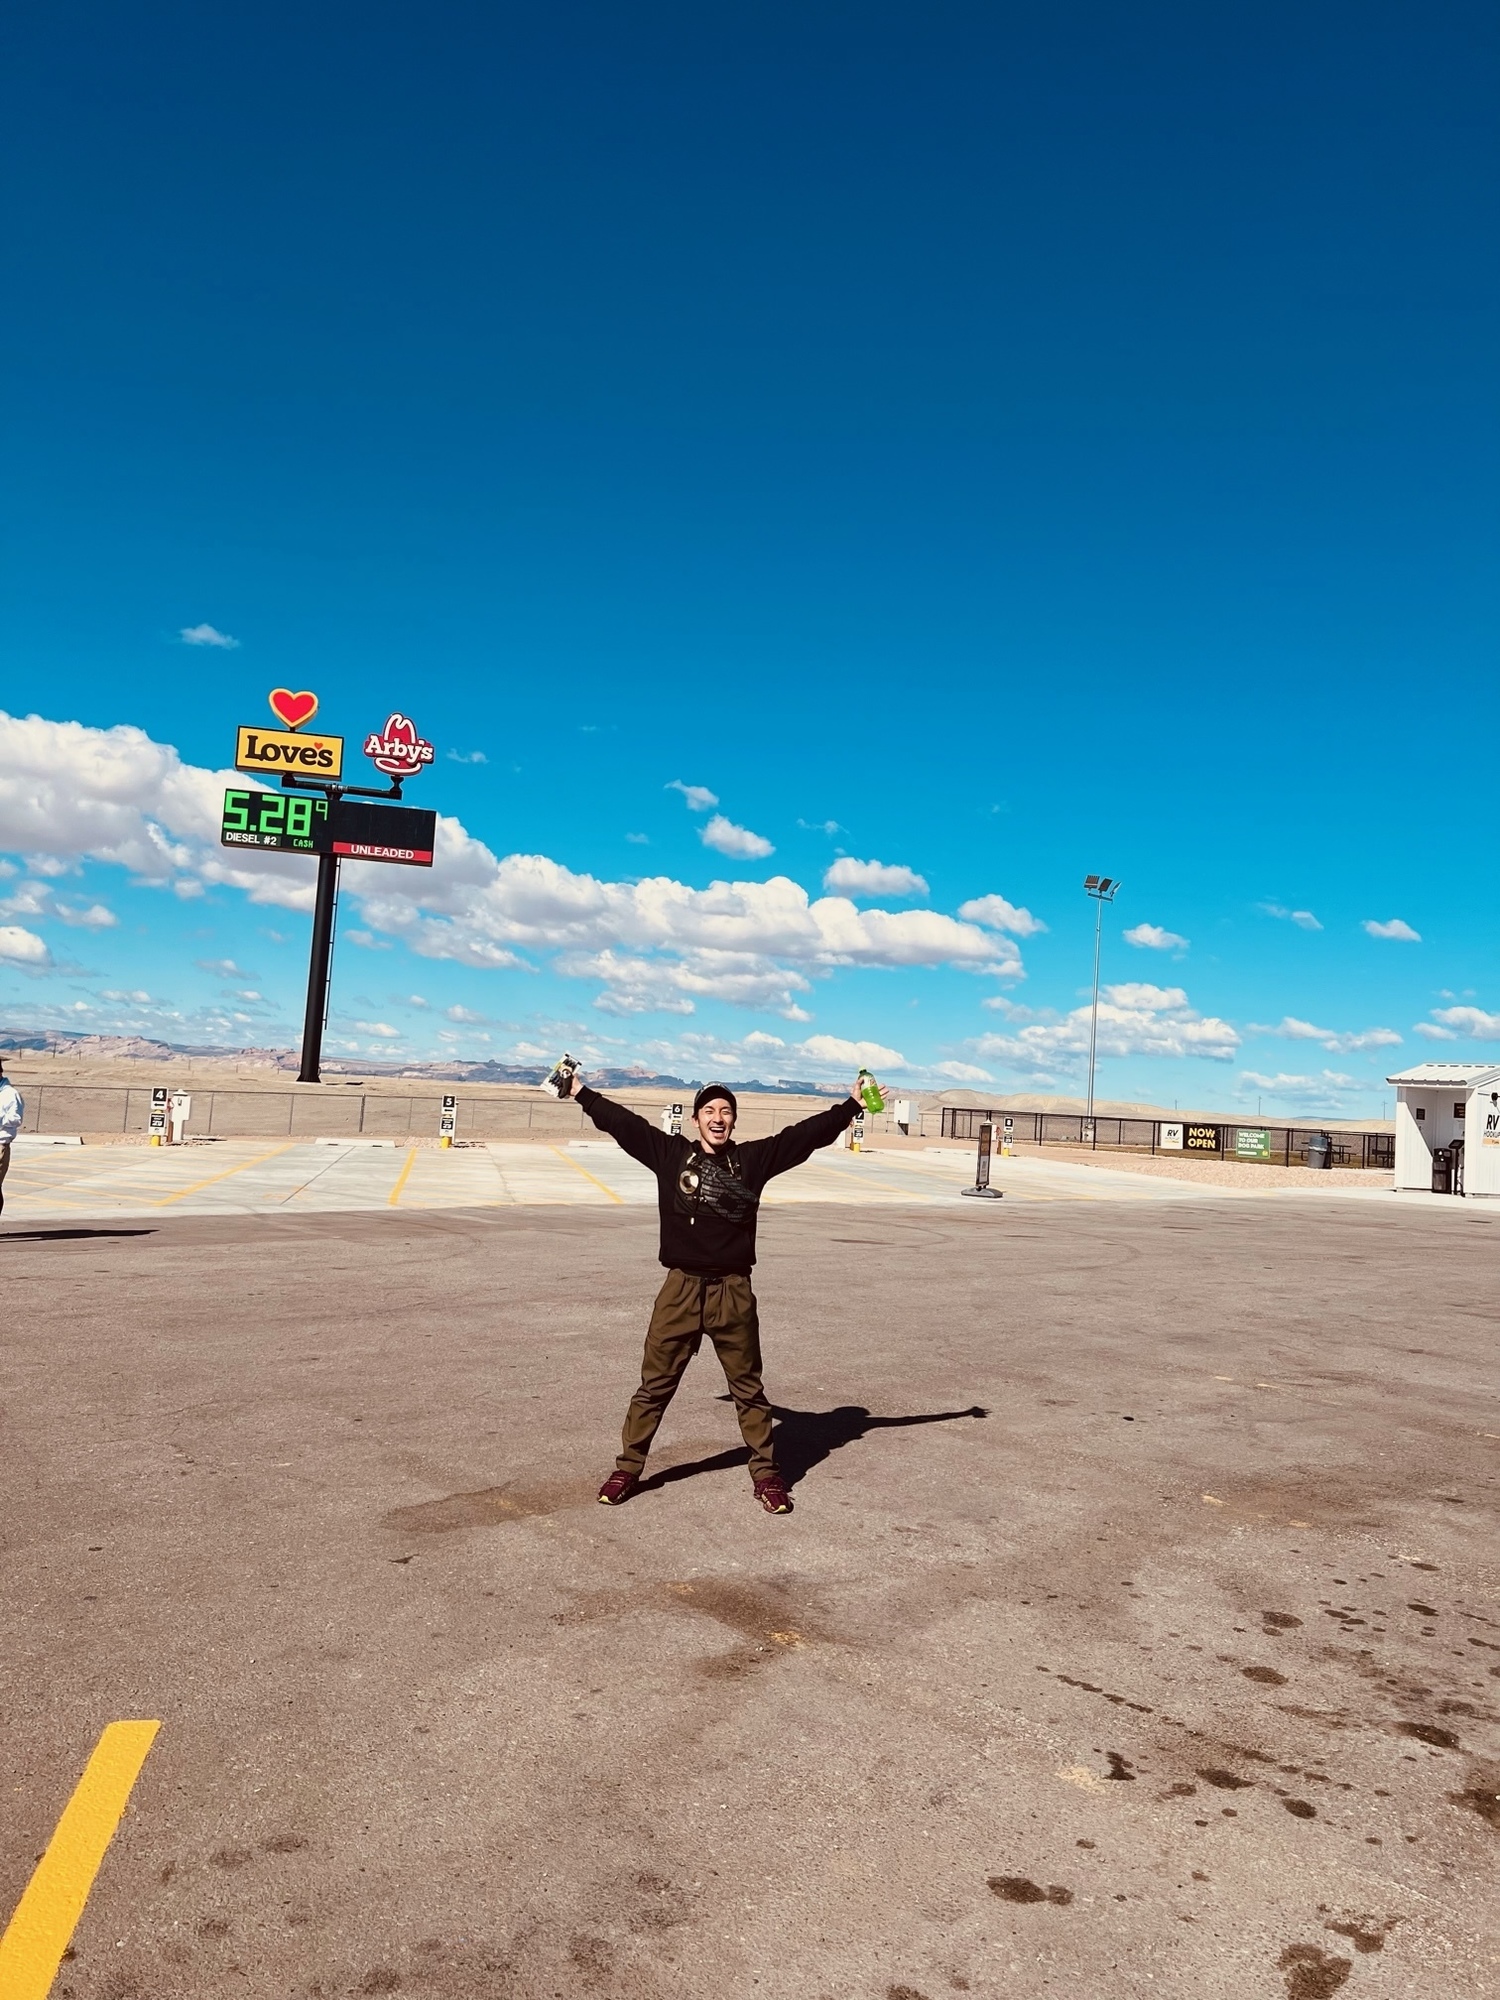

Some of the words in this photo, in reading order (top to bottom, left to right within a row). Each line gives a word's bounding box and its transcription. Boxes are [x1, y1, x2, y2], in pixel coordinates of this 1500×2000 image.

[365, 735, 433, 763] Arby's
[226, 831, 260, 844] DIESEL
[263, 835, 277, 846] #2
[293, 838, 314, 849] CASH
[350, 844, 414, 859] UNLEADED
[155, 1090, 164, 1100] 4
[446, 1097, 453, 1106] 5
[674, 1105, 681, 1113] 6
[1486, 1114, 1500, 1131] RV
[1167, 1129, 1179, 1137] RV
[1189, 1127, 1216, 1138] NOW
[1187, 1138, 1216, 1149] OPEN
